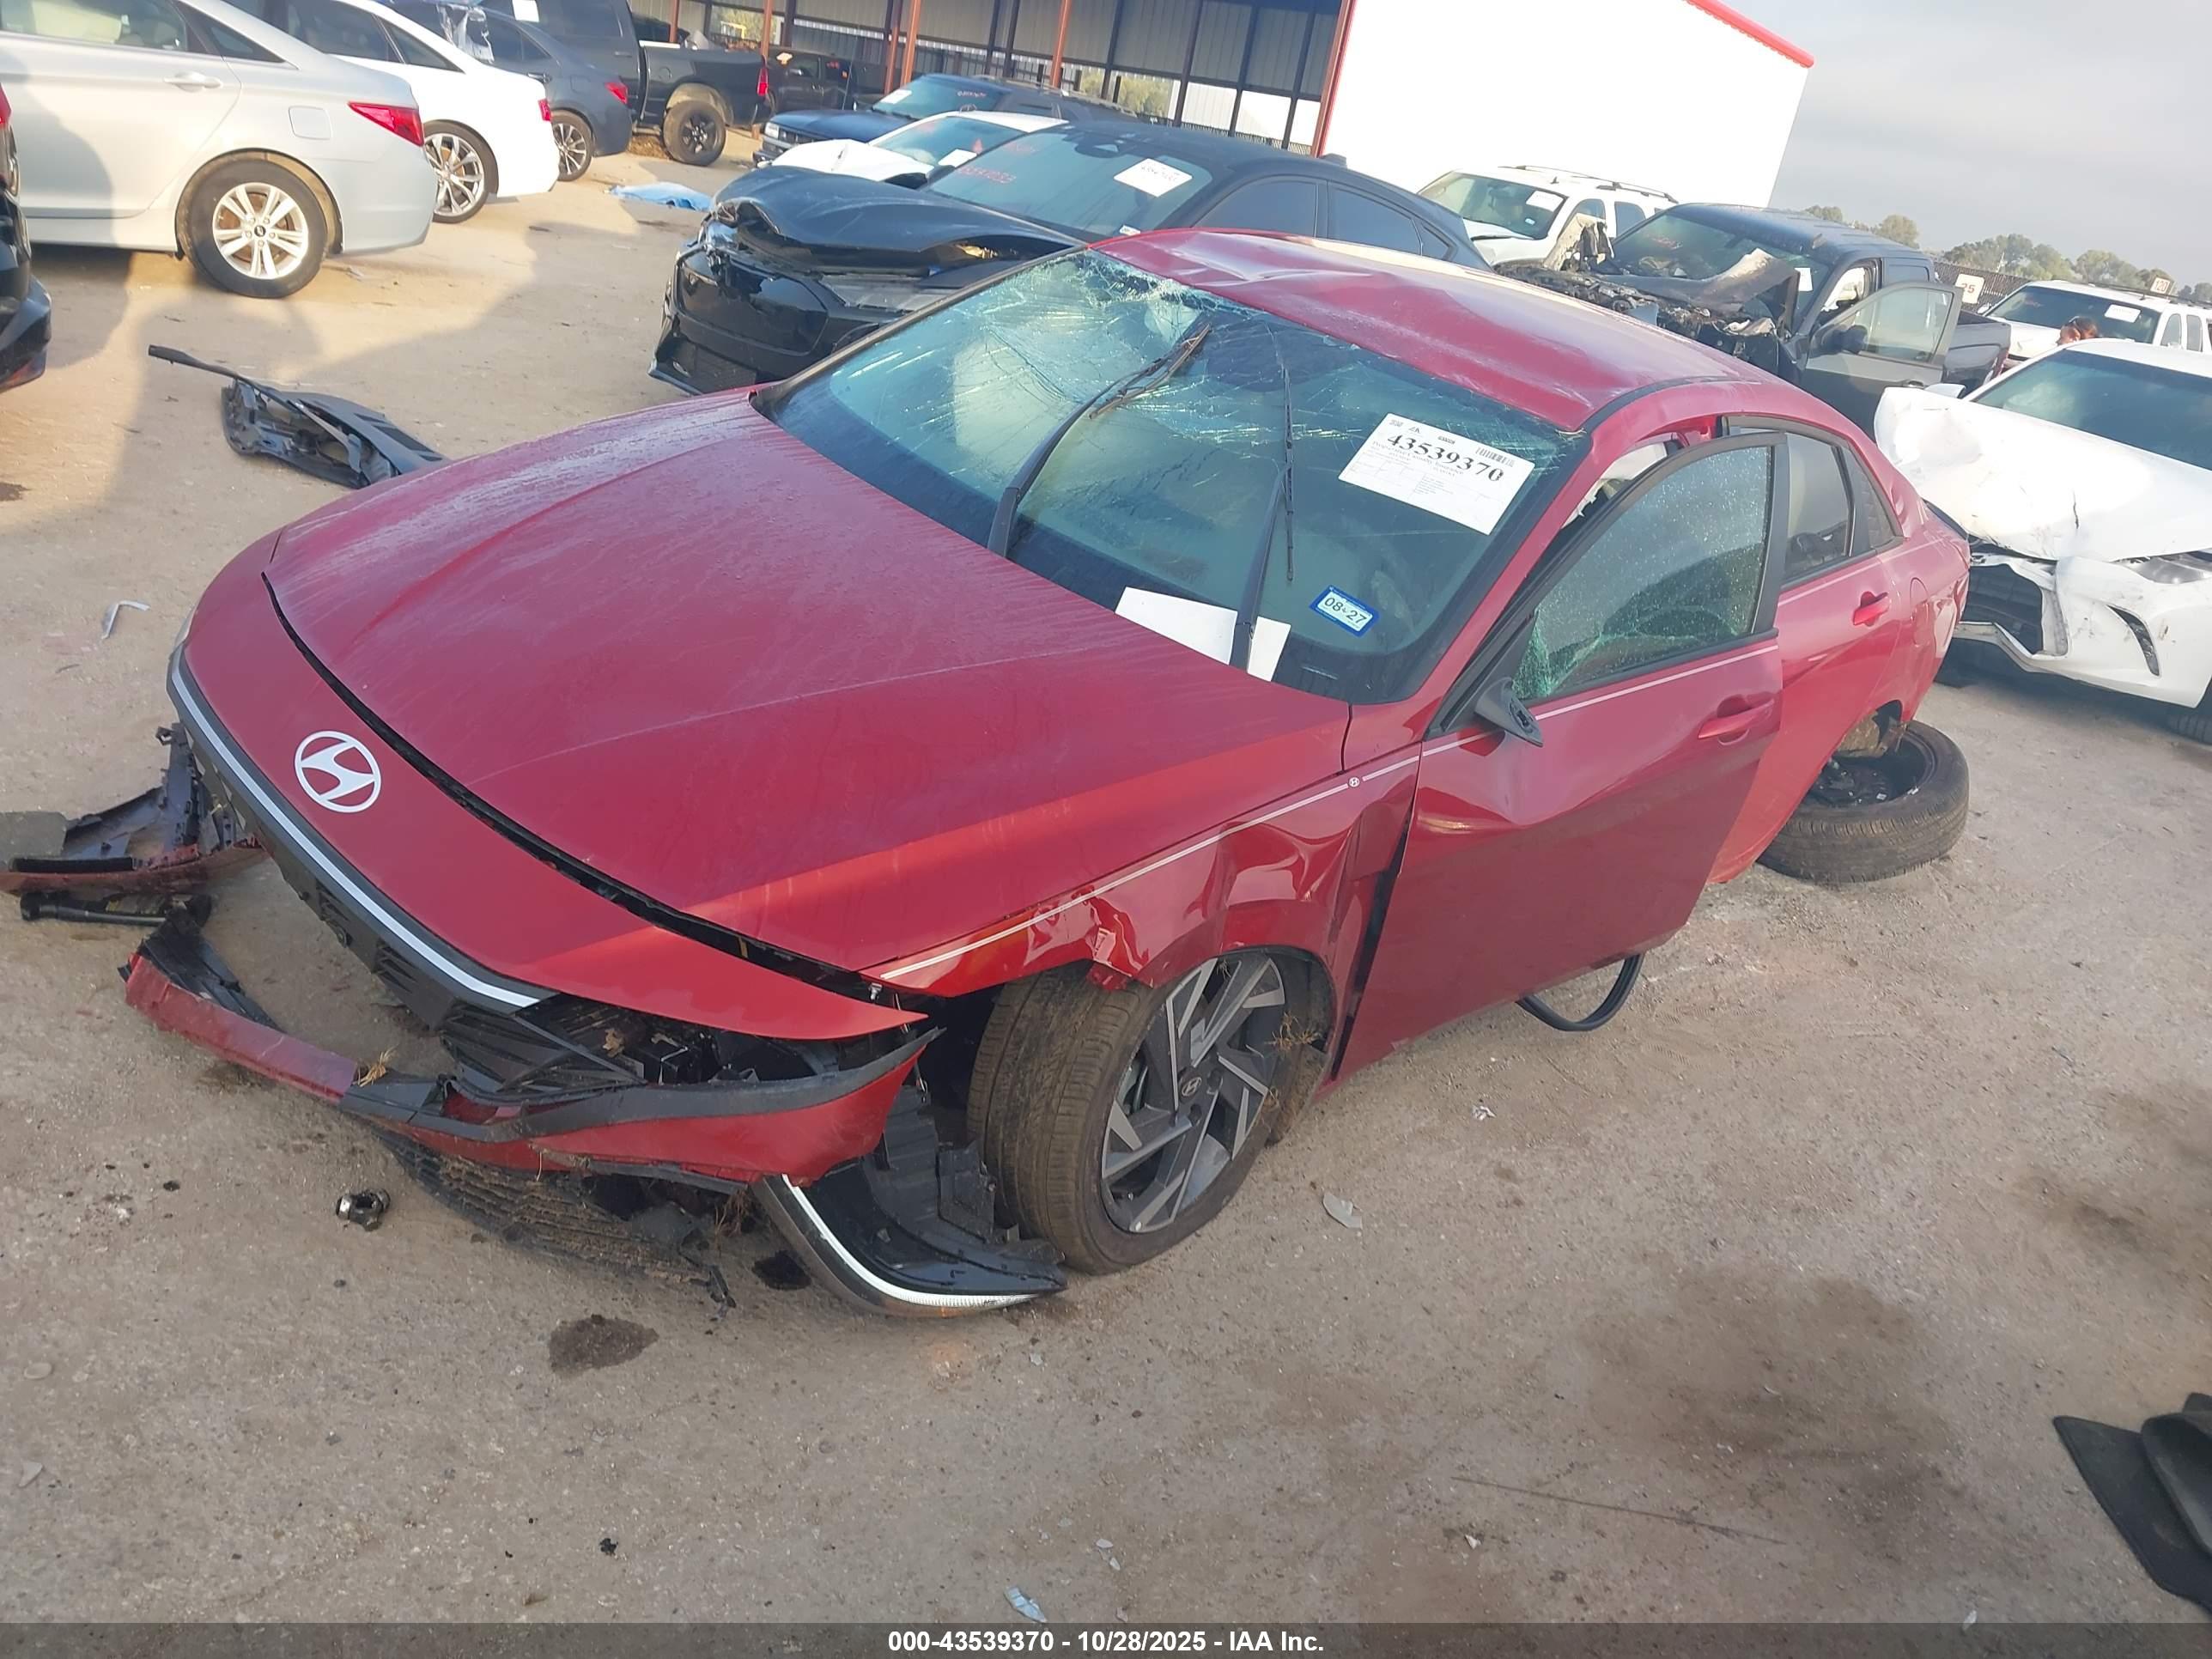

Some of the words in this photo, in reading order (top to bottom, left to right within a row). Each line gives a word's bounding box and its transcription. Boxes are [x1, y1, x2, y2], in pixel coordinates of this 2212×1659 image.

[1387, 434, 1504, 482] 43539370
[1324, 597, 1344, 611] 08
[1346, 610, 1367, 623] 27
